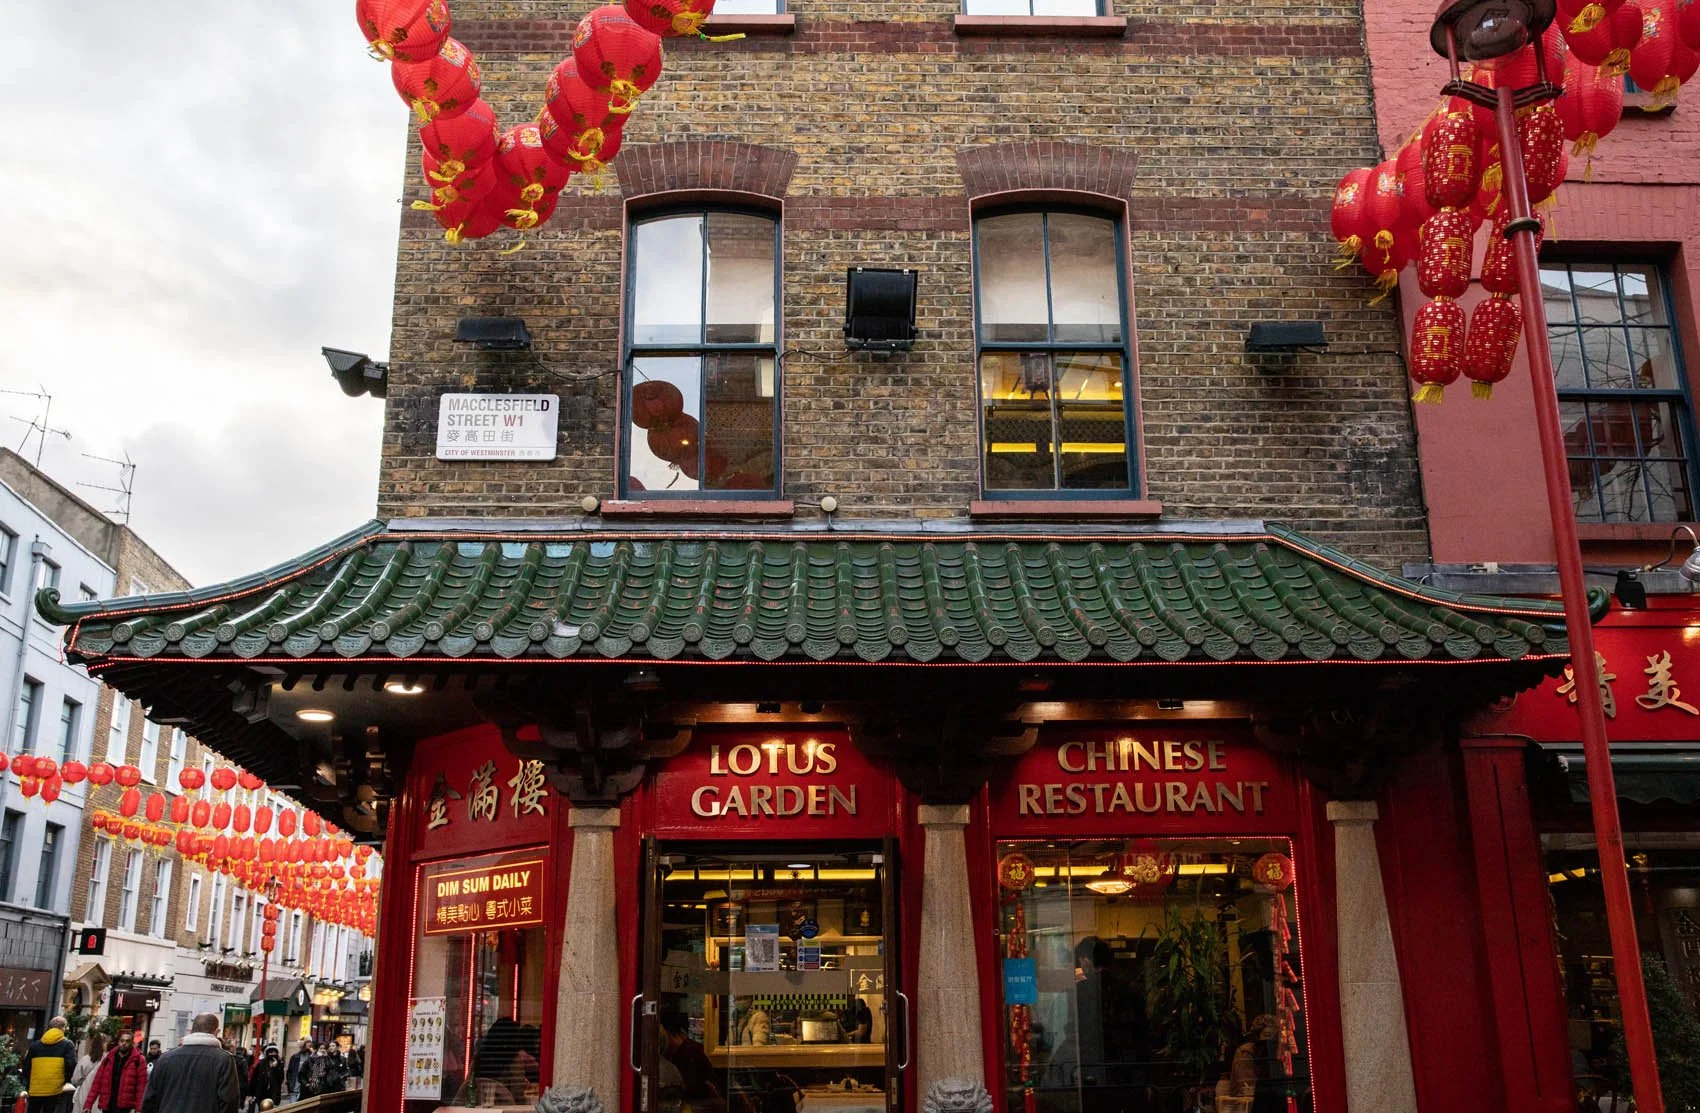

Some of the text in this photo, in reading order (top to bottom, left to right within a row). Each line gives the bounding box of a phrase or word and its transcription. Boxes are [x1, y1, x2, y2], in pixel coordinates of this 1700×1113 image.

[447, 414, 524, 427] STREET W1
[448, 399, 550, 412] MACCLESFIELD
[444, 449, 457, 457] CITY
[460, 449, 469, 457] OF
[470, 449, 516, 457] WESTMINSTER
[709, 742, 837, 775] LOTUS
[1057, 739, 1227, 773] CHINESE
[691, 783, 857, 817] GARDEN
[1018, 780, 1268, 815] RESTAURANT
[437, 870, 531, 897] DIM SUM DAILY
